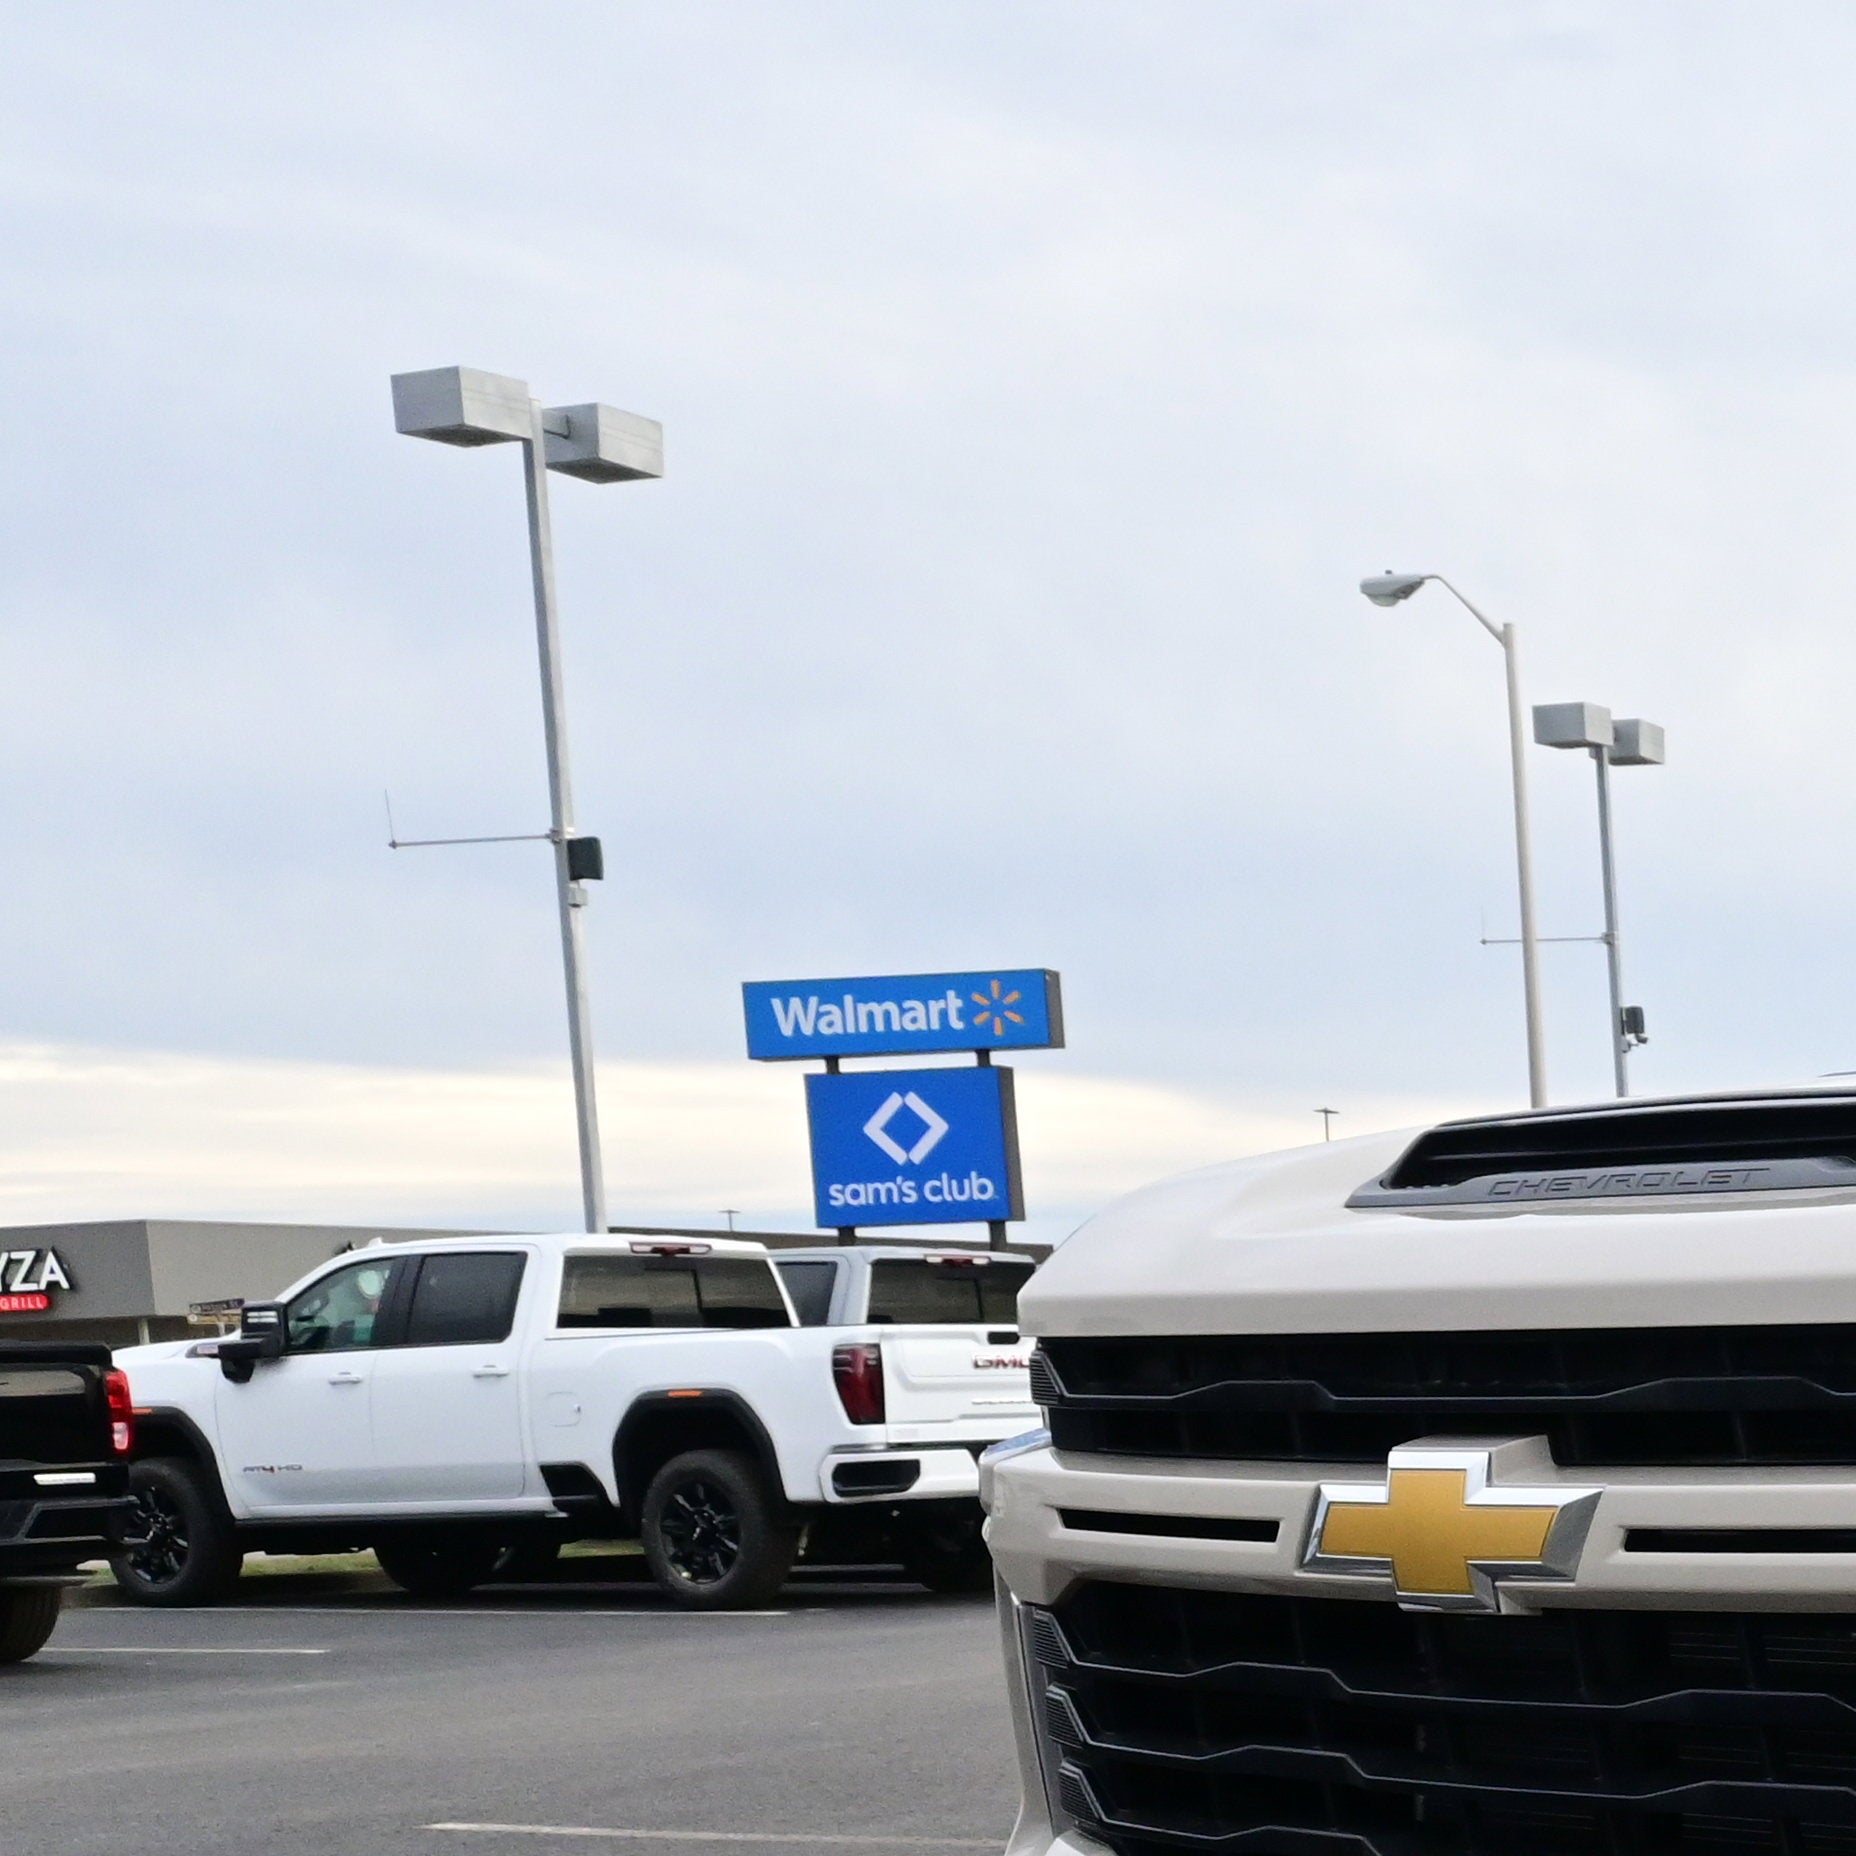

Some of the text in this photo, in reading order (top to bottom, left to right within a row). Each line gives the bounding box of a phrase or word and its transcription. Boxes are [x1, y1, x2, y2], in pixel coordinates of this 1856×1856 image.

[771, 989, 965, 1038] Walmart
[828, 1171, 994, 1207] sam's club
[1487, 1167, 1771, 1197] CHEVROLET
[0, 1296, 44, 1310] GRILL
